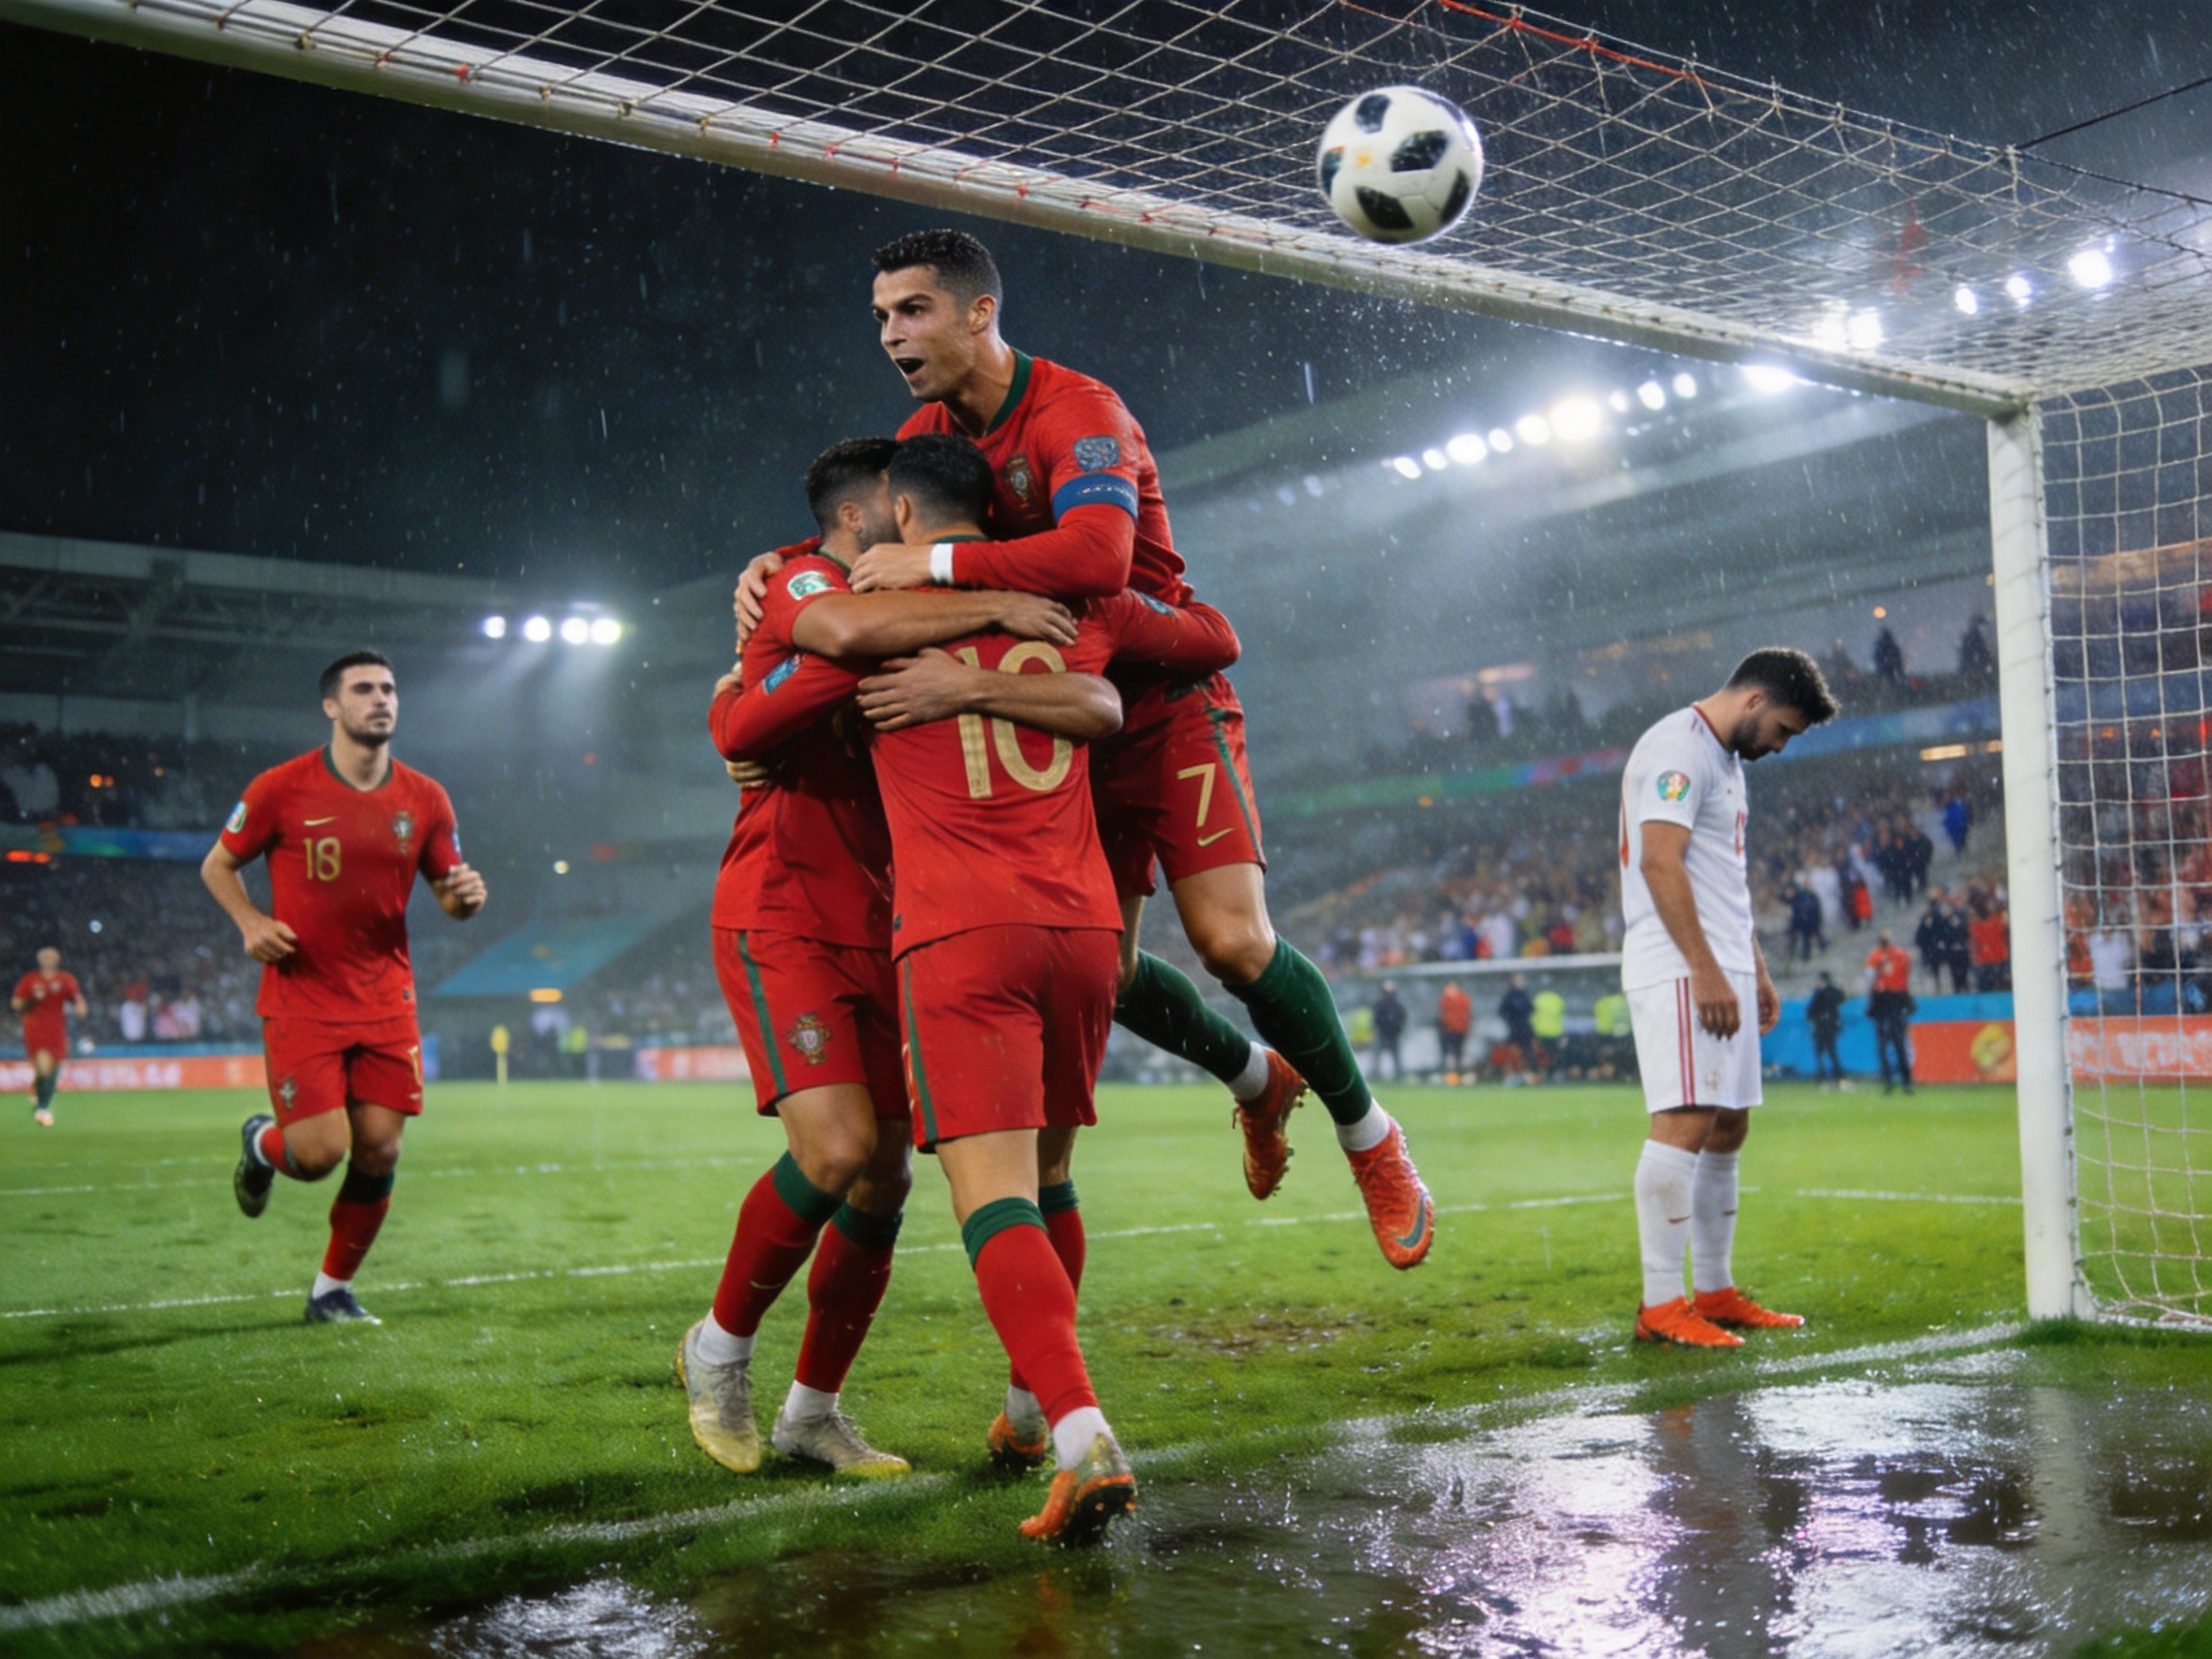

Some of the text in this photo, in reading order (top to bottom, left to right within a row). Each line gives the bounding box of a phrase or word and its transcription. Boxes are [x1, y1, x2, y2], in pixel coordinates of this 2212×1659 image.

[954, 640, 1073, 799] 10
[1176, 762, 1216, 828] 7
[303, 837, 341, 881] 18
